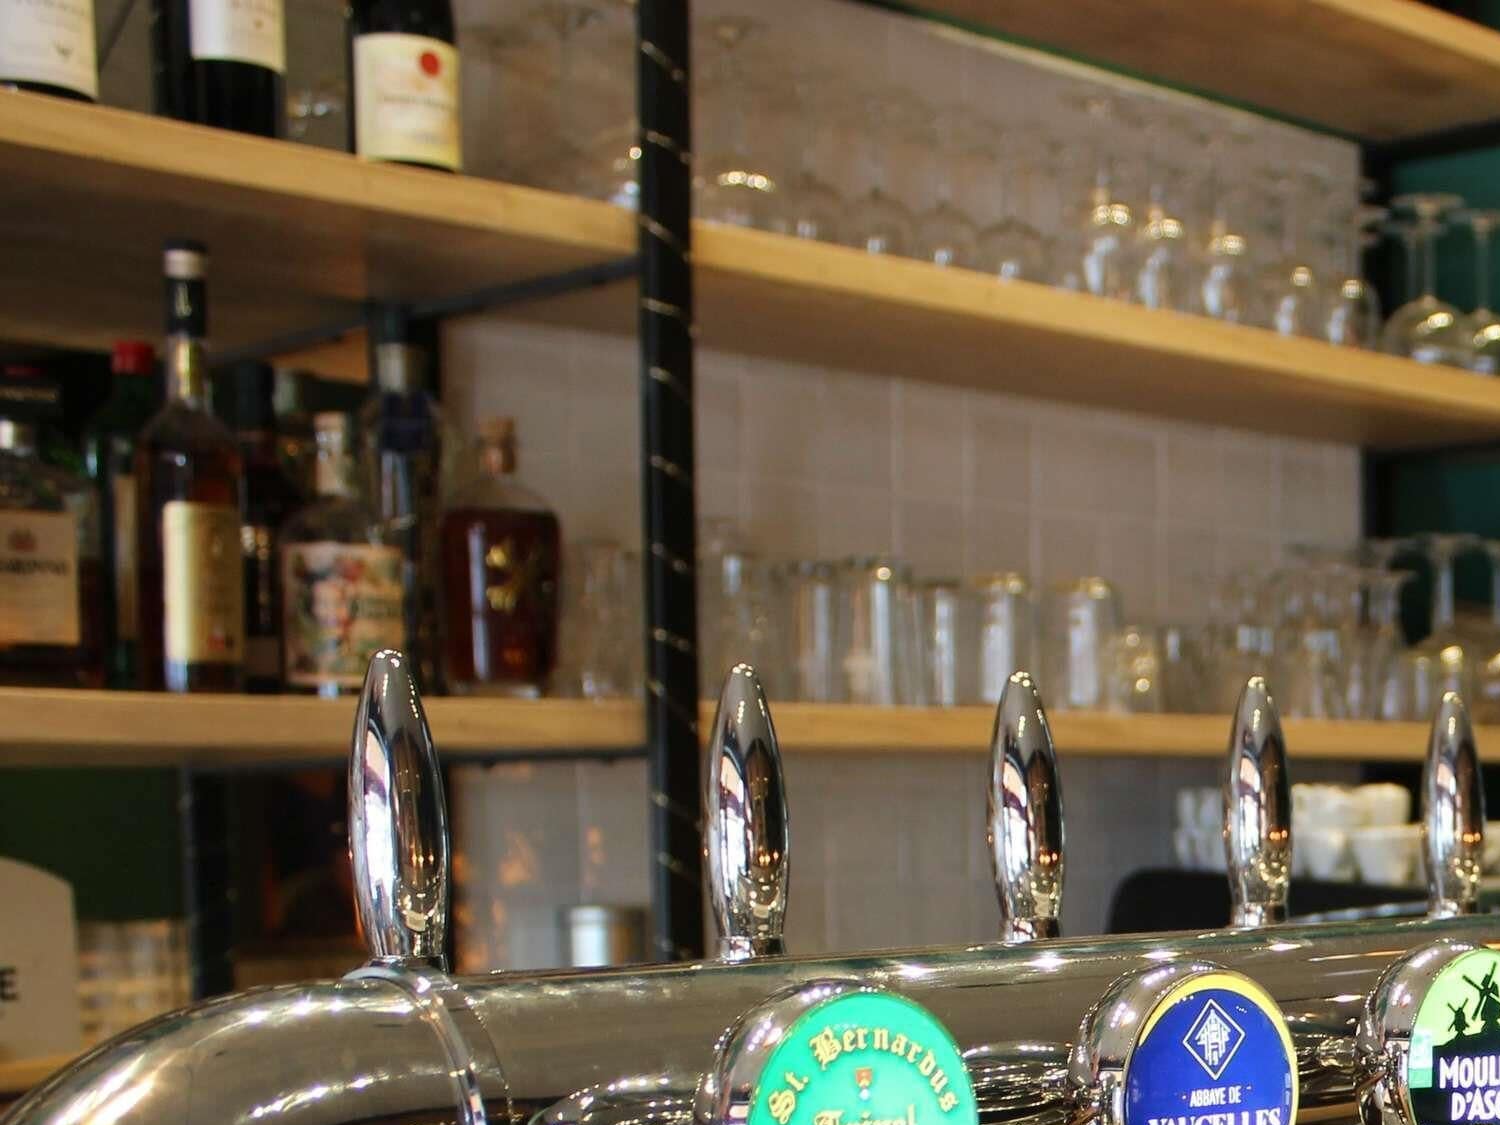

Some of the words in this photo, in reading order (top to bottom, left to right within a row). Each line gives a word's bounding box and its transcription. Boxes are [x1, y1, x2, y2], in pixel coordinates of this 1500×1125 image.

[768, 1071, 809, 1125] St.
[809, 1026, 959, 1113] Bernardus
[1189, 1087, 1226, 1107] ABBAYE
[1228, 1086, 1242, 1105] DE
